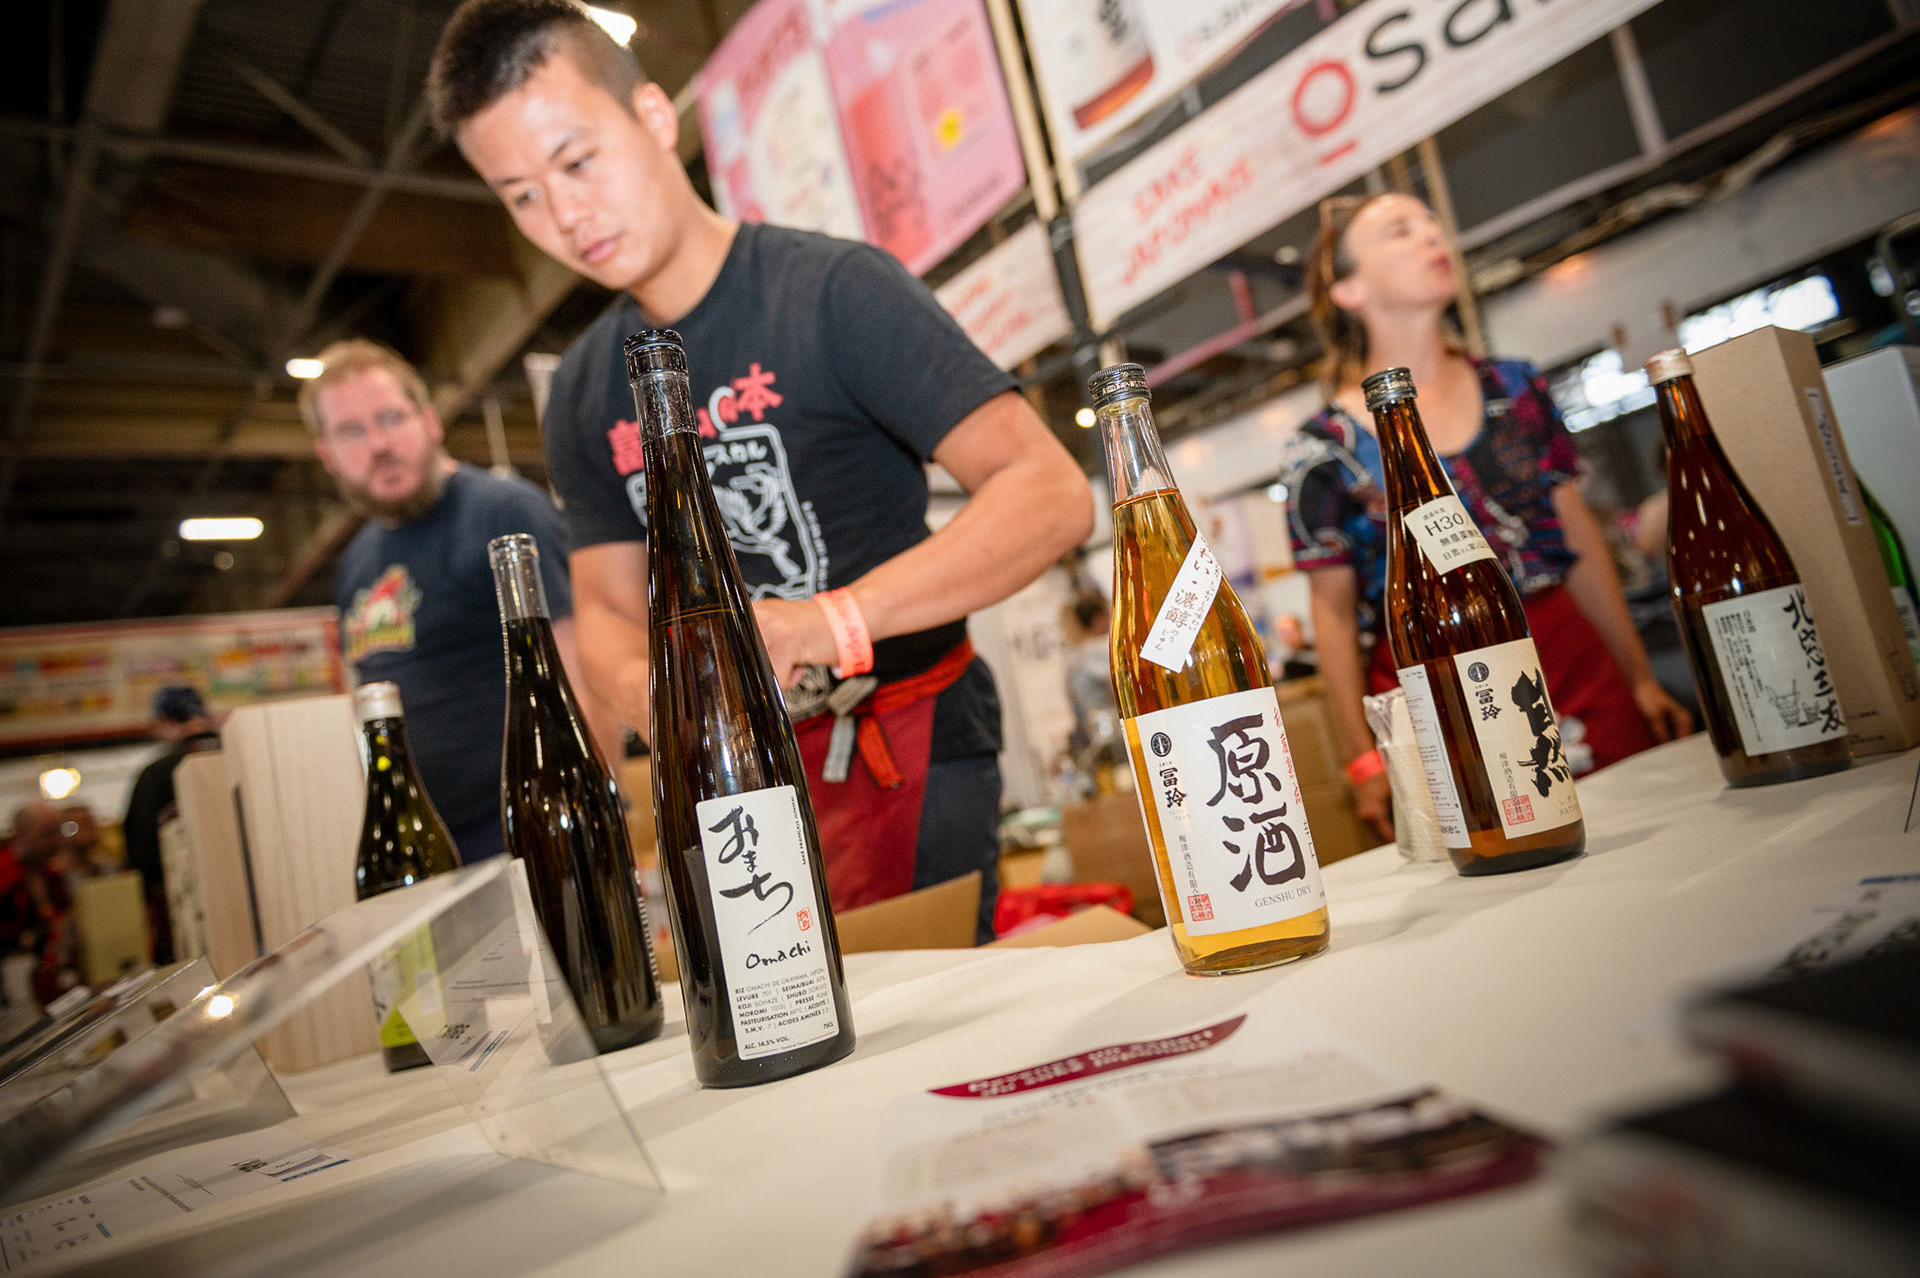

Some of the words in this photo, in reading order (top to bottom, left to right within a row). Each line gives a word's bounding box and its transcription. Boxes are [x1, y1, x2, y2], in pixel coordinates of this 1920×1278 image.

[1206, 712, 1306, 893] 原酒
[1254, 890, 1296, 909] GENSHU
[1296, 884, 1313, 900] DRY
[745, 940, 811, 969] Omachi
[736, 993, 759, 1003] LEVURE
[737, 1002, 752, 1010] KOJI
[786, 989, 807, 1000] SHUBO
[739, 1008, 768, 1018] MOROMI
[795, 995, 815, 1006] PRESSE
[740, 1011, 789, 1026] PASTEURISATION
[778, 1017, 800, 1027] ACIDES
[800, 1010, 821, 1022] AMINÉS
